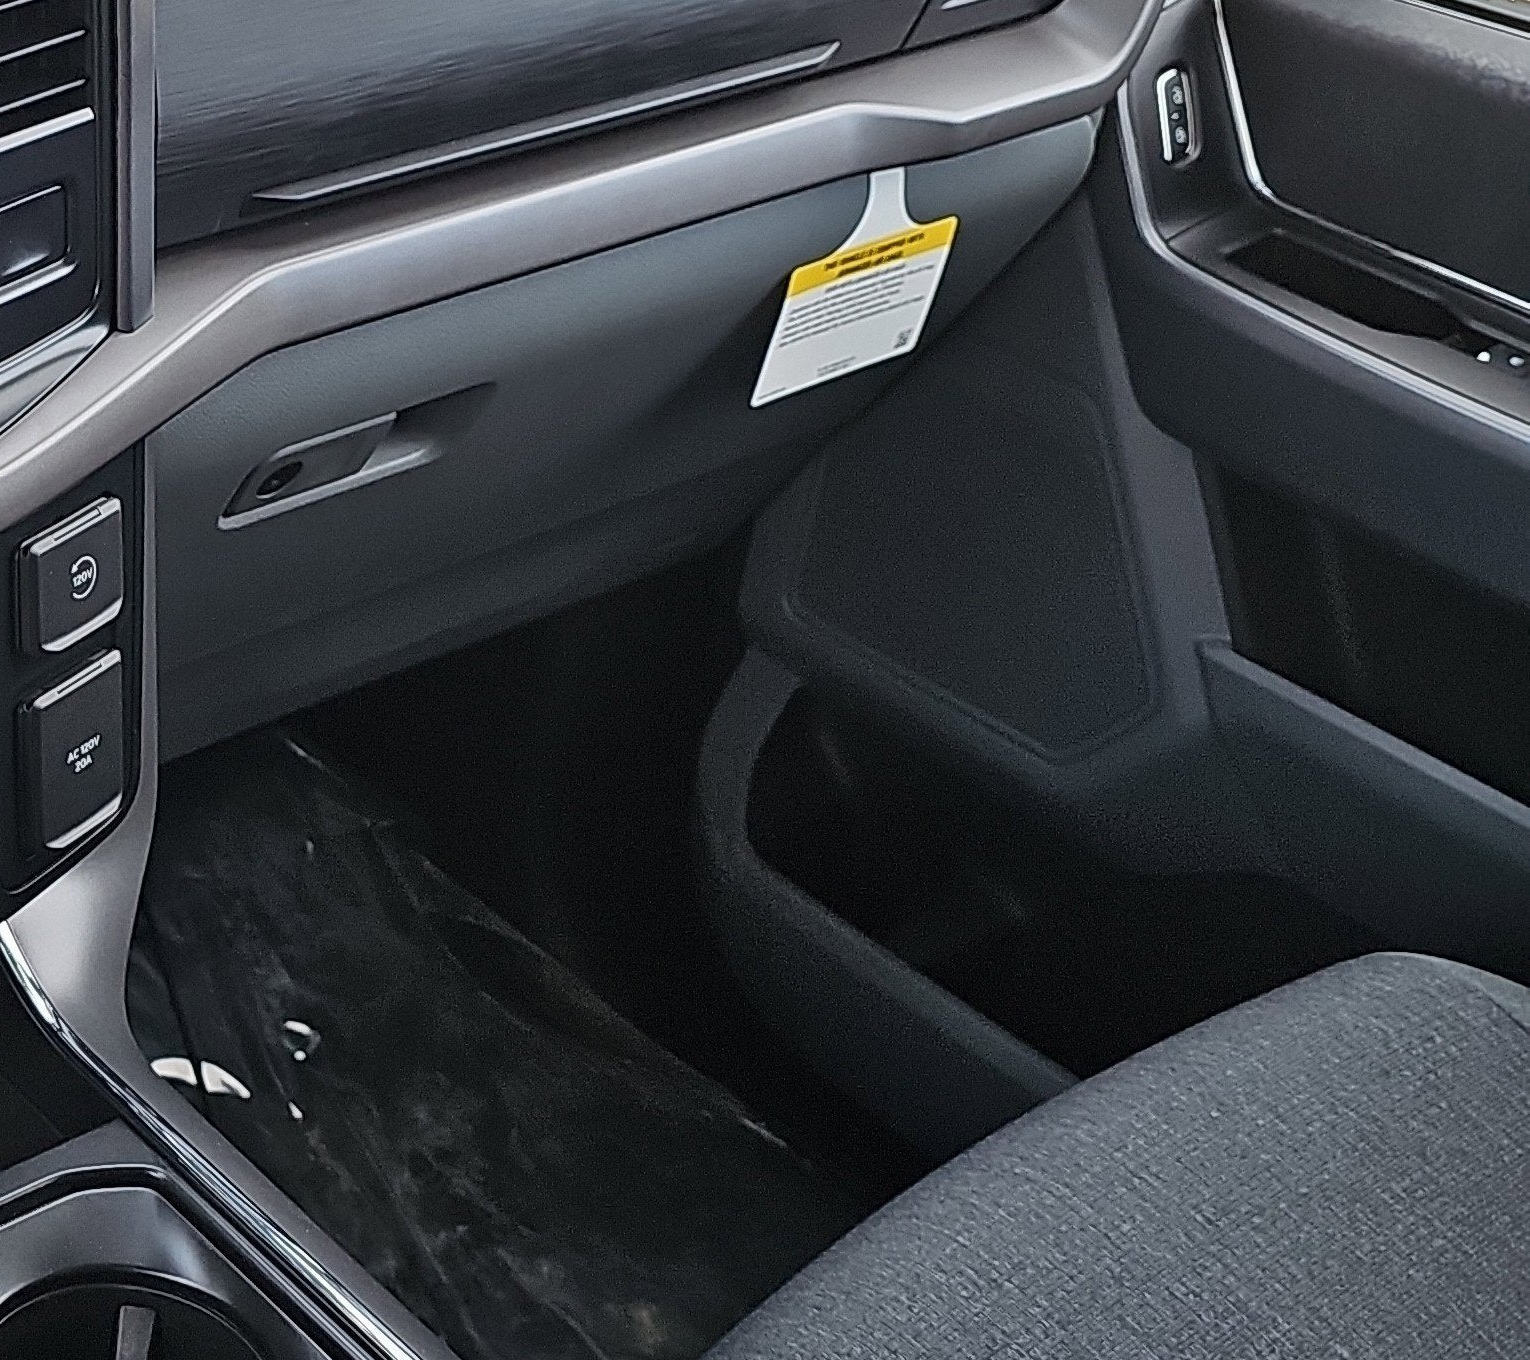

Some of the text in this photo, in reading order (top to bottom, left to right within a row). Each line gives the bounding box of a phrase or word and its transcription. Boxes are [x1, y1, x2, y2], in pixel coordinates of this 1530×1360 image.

[73, 567, 93, 587] 120V
[67, 735, 101, 764] AC 120V
[75, 755, 93, 773] 20A
